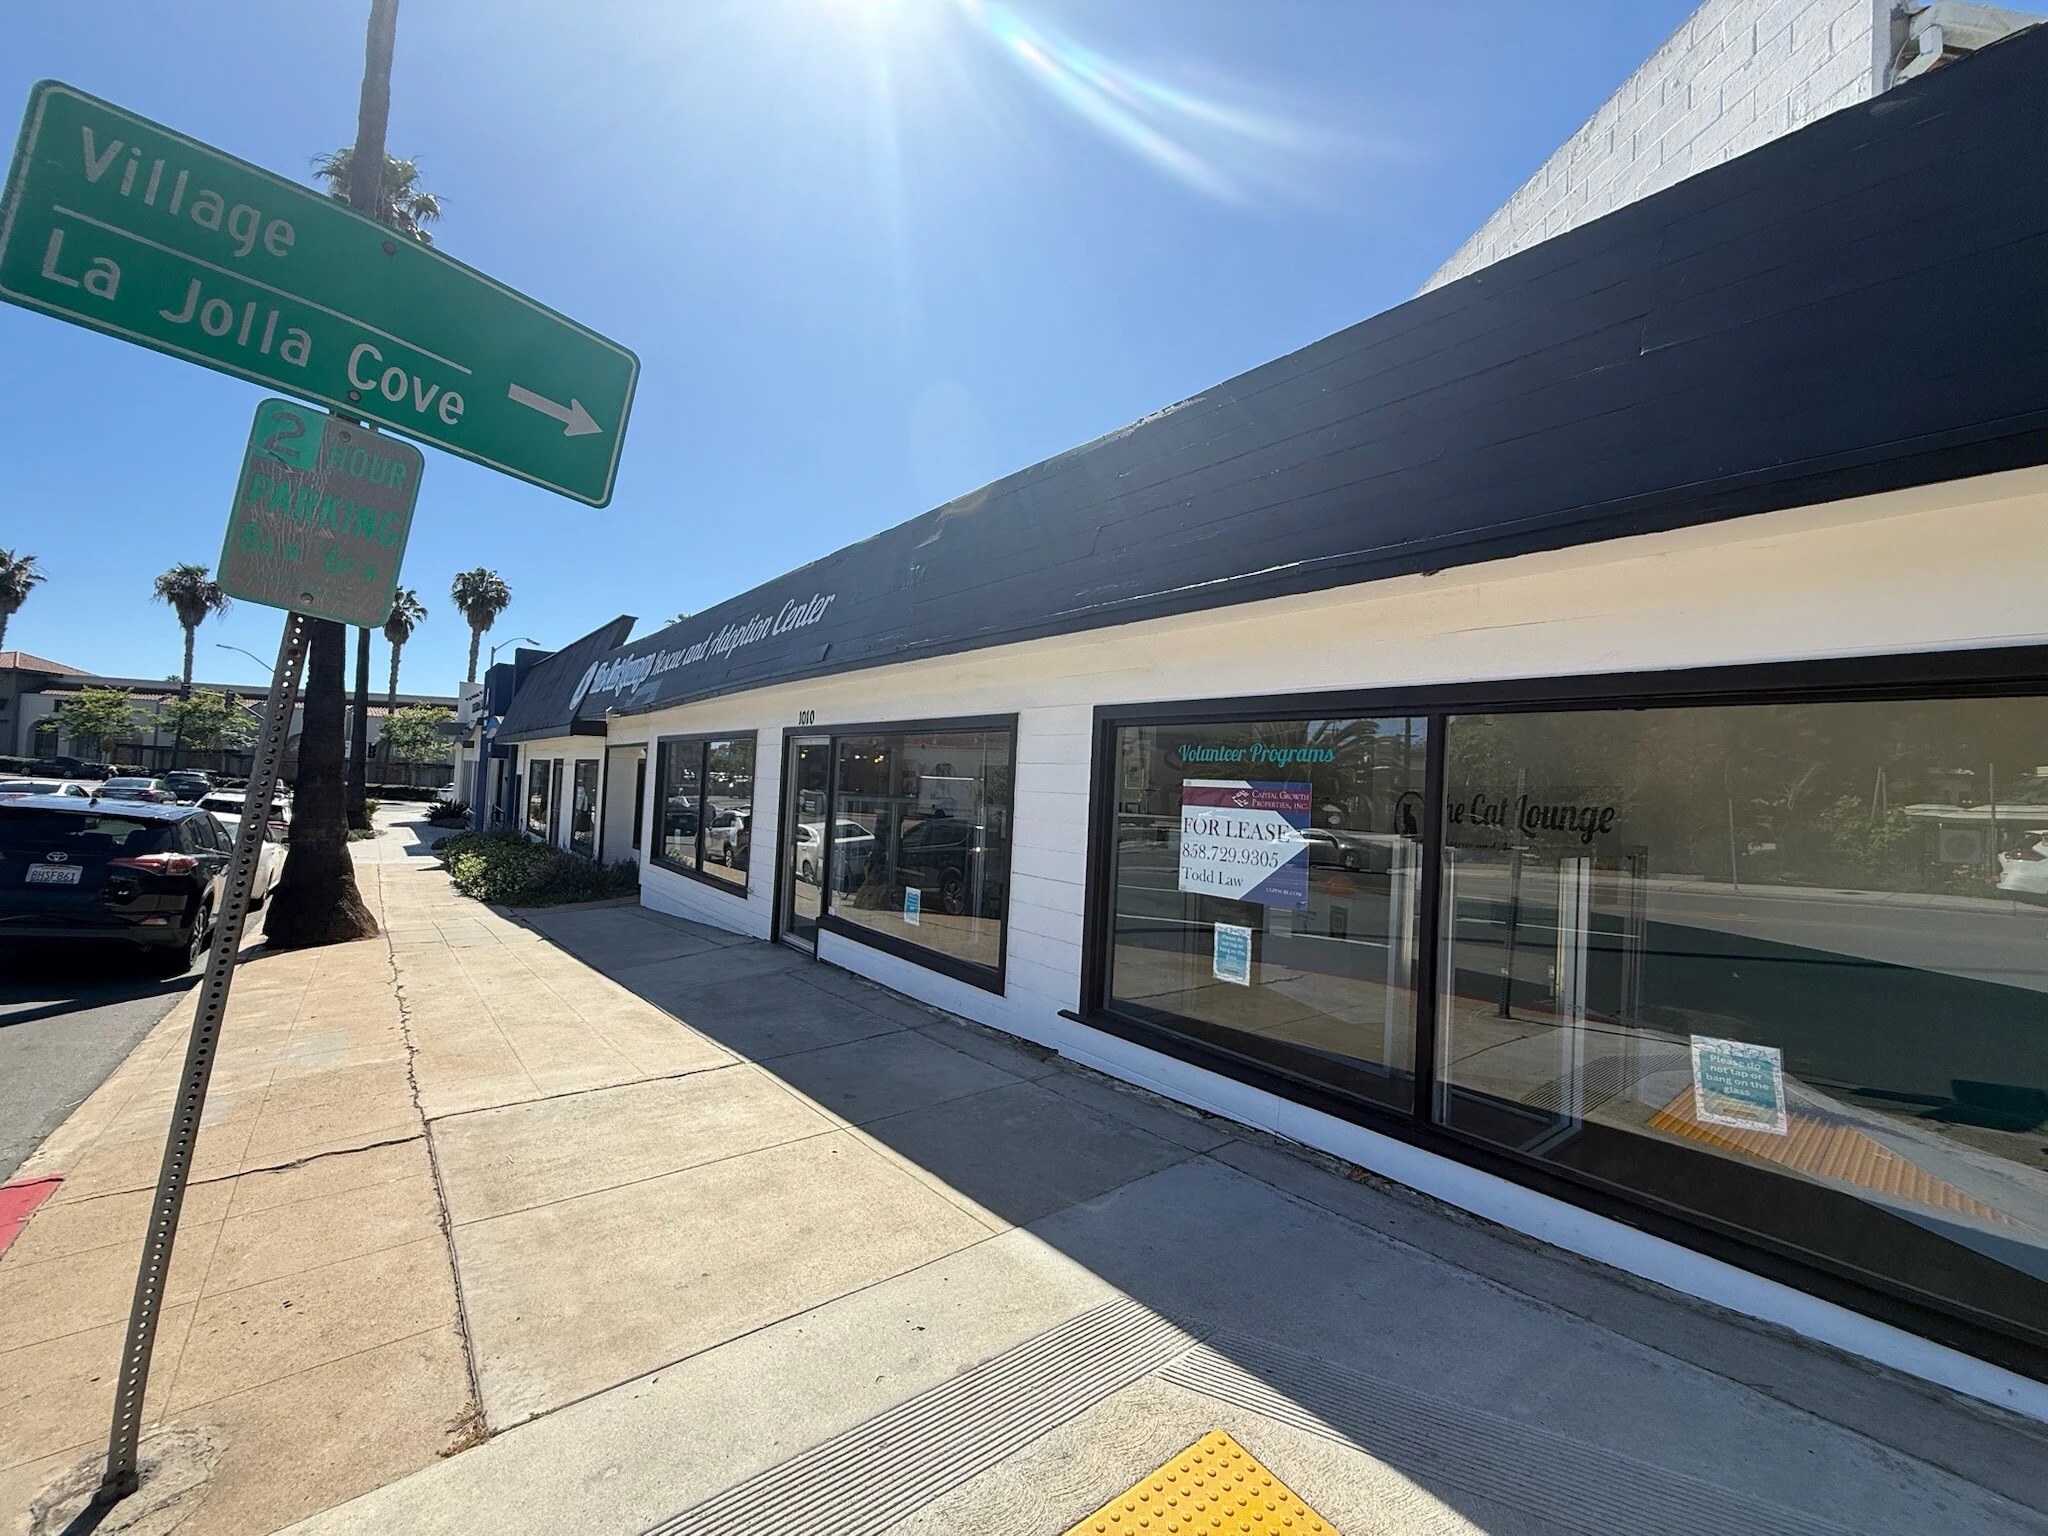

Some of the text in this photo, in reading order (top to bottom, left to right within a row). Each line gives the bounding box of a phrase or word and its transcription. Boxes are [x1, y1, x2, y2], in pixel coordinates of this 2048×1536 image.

[81, 126, 296, 258] Village
[41, 227, 466, 426] La Jolla Cove
[263, 411, 407, 491] 2 HOUR
[248, 472, 400, 548] PARKING
[683, 633, 710, 666] and
[706, 614, 772, 662] Adoption
[772, 593, 836, 637] Center
[798, 710, 815, 725] 1010
[1178, 743, 1336, 767] Volunteer Programs
[1183, 817, 1290, 843] FOR LEASE
[1470, 793, 1508, 827] Cat
[1514, 794, 1616, 845] Lounge
[1182, 843, 1279, 868] 858.729.9305
[30, 870, 76, 880] 8HSF861
[1182, 866, 1244, 887] Todd Law
[1710, 1054, 1761, 1071] Please do
[1710, 1065, 1728, 1074] not
[1729, 1068, 1749, 1079] tap
[1705, 1072, 1733, 1086] bang
[1750, 1081, 1770, 1091] the
[1723, 1085, 1751, 1097] glass
